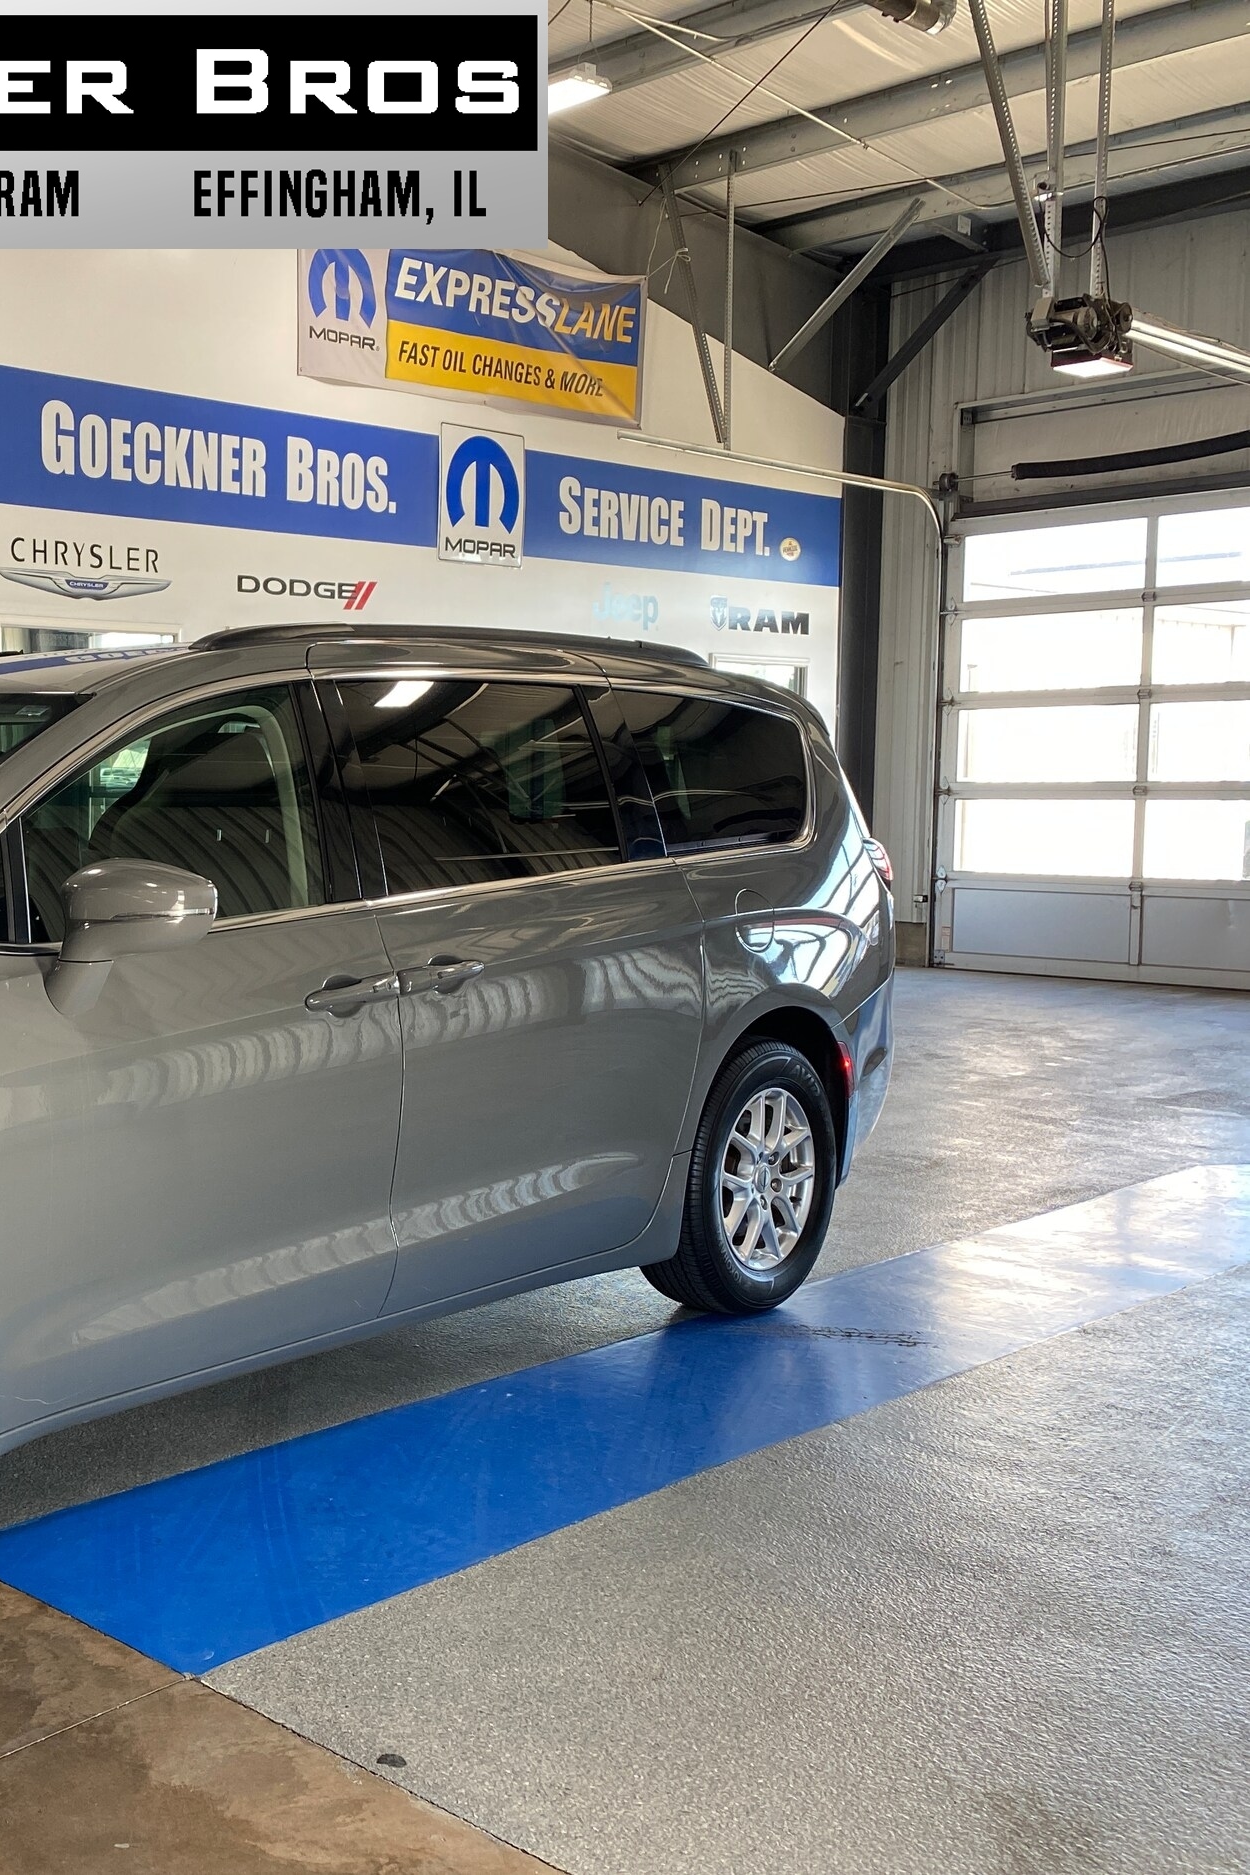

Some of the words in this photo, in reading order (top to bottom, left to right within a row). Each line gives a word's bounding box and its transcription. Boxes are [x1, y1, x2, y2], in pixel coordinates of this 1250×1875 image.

[398, 340, 441, 368] FAST
[442, 348, 467, 374] OIL
[472, 354, 541, 388] CHANGES
[545, 368, 556, 388] &
[560, 371, 604, 397] MORE
[41, 399, 267, 498] GOECKNER
[286, 435, 397, 514] BROS.
[559, 476, 685, 547] SERVICE
[701, 498, 771, 557] DEPT.
[10, 537, 159, 573] CHRYSLER
[445, 537, 516, 559] MOPAR
[236, 575, 358, 600] DODGE
[592, 582, 659, 631] Jeep
[728, 606, 810, 635] RAM
